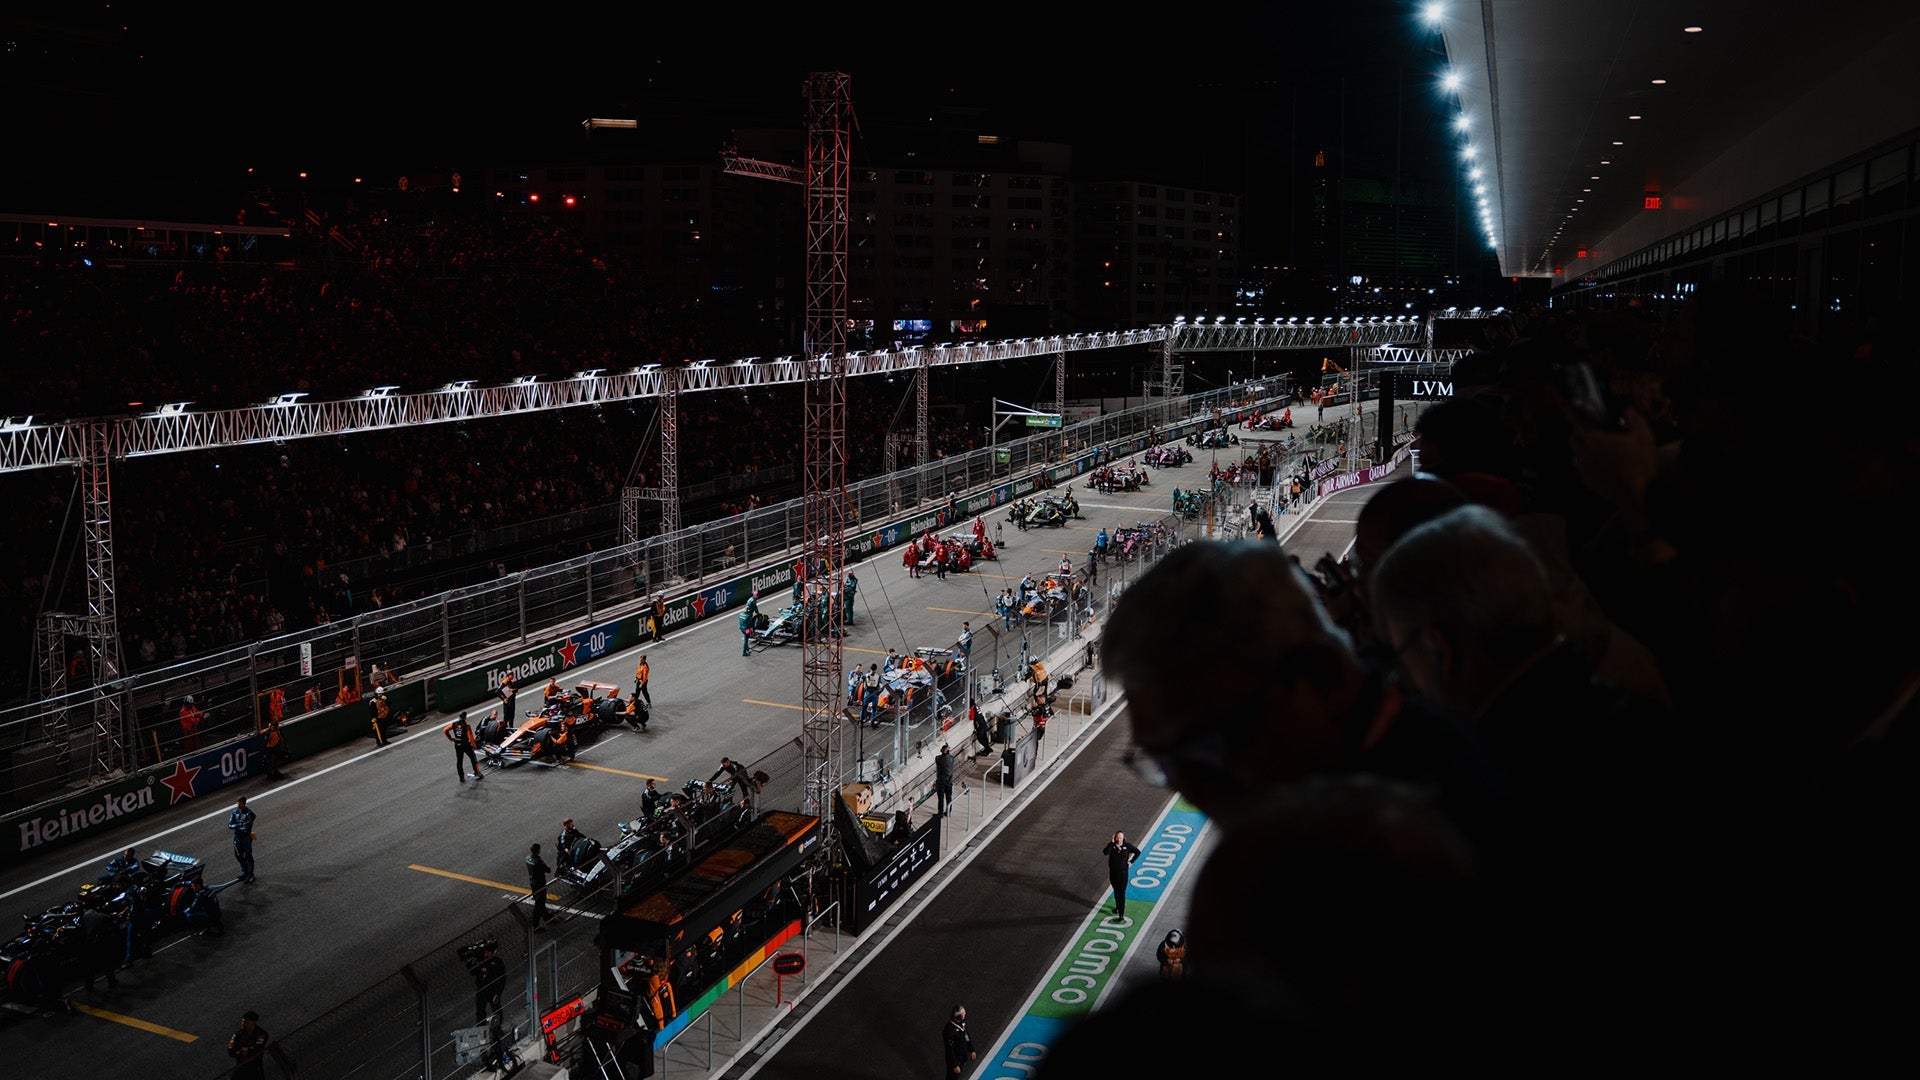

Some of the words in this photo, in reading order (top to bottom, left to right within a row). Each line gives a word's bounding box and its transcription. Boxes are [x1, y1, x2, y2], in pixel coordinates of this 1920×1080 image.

[1645, 197, 1660, 209] EXIT
[751, 568, 791, 593] Heineken
[221, 747, 248, 777] 0.0
[18, 785, 155, 851] Heineken
[1130, 824, 1193, 889] aramco
[1051, 915, 1134, 1004] aramco
[551, 1006, 576, 1024] OSCAR
